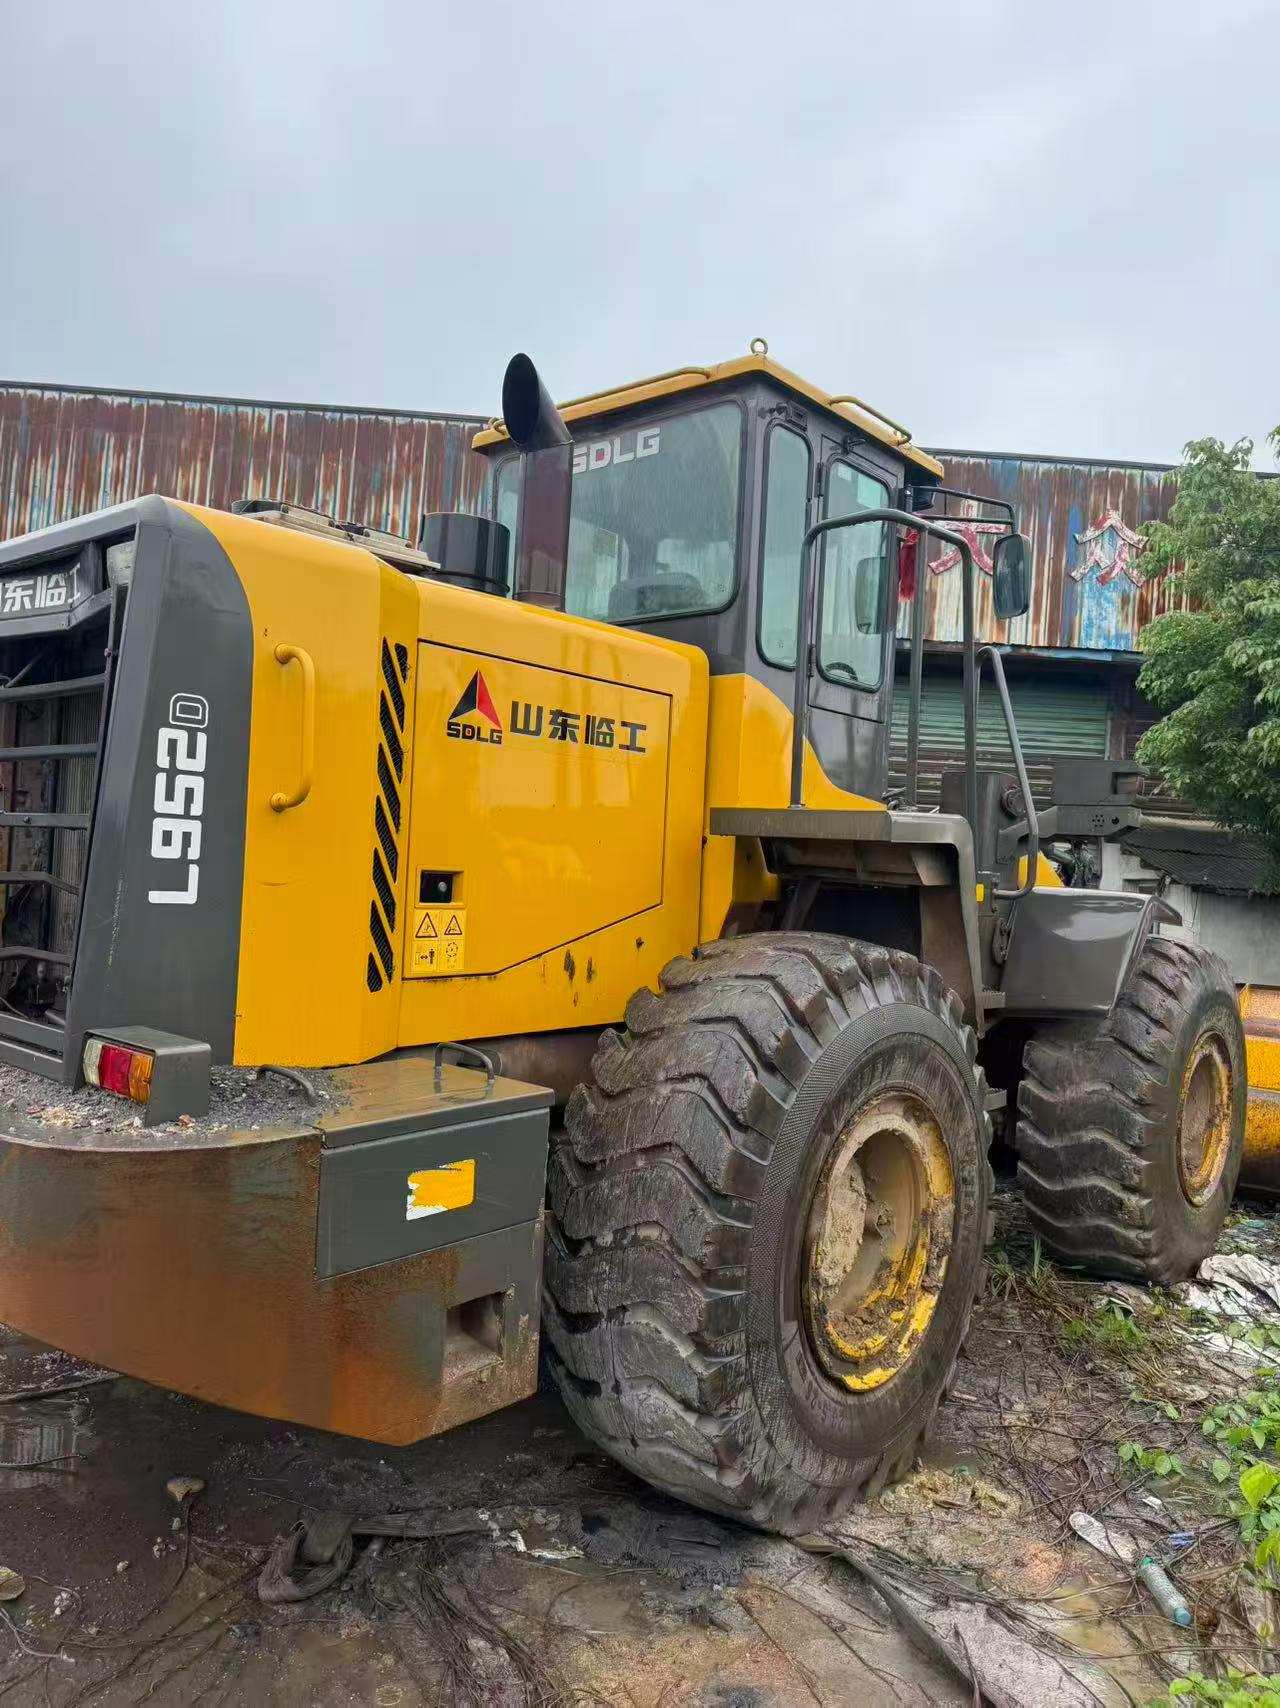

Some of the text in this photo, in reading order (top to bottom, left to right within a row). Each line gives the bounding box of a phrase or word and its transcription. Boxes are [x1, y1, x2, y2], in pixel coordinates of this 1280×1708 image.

[572, 427, 661, 474] SDLG
[0, 561, 81, 613] 东临工
[446, 720, 503, 745] SDLG
[510, 700, 647, 753] 山东临工
[148, 692, 209, 905] L952D
